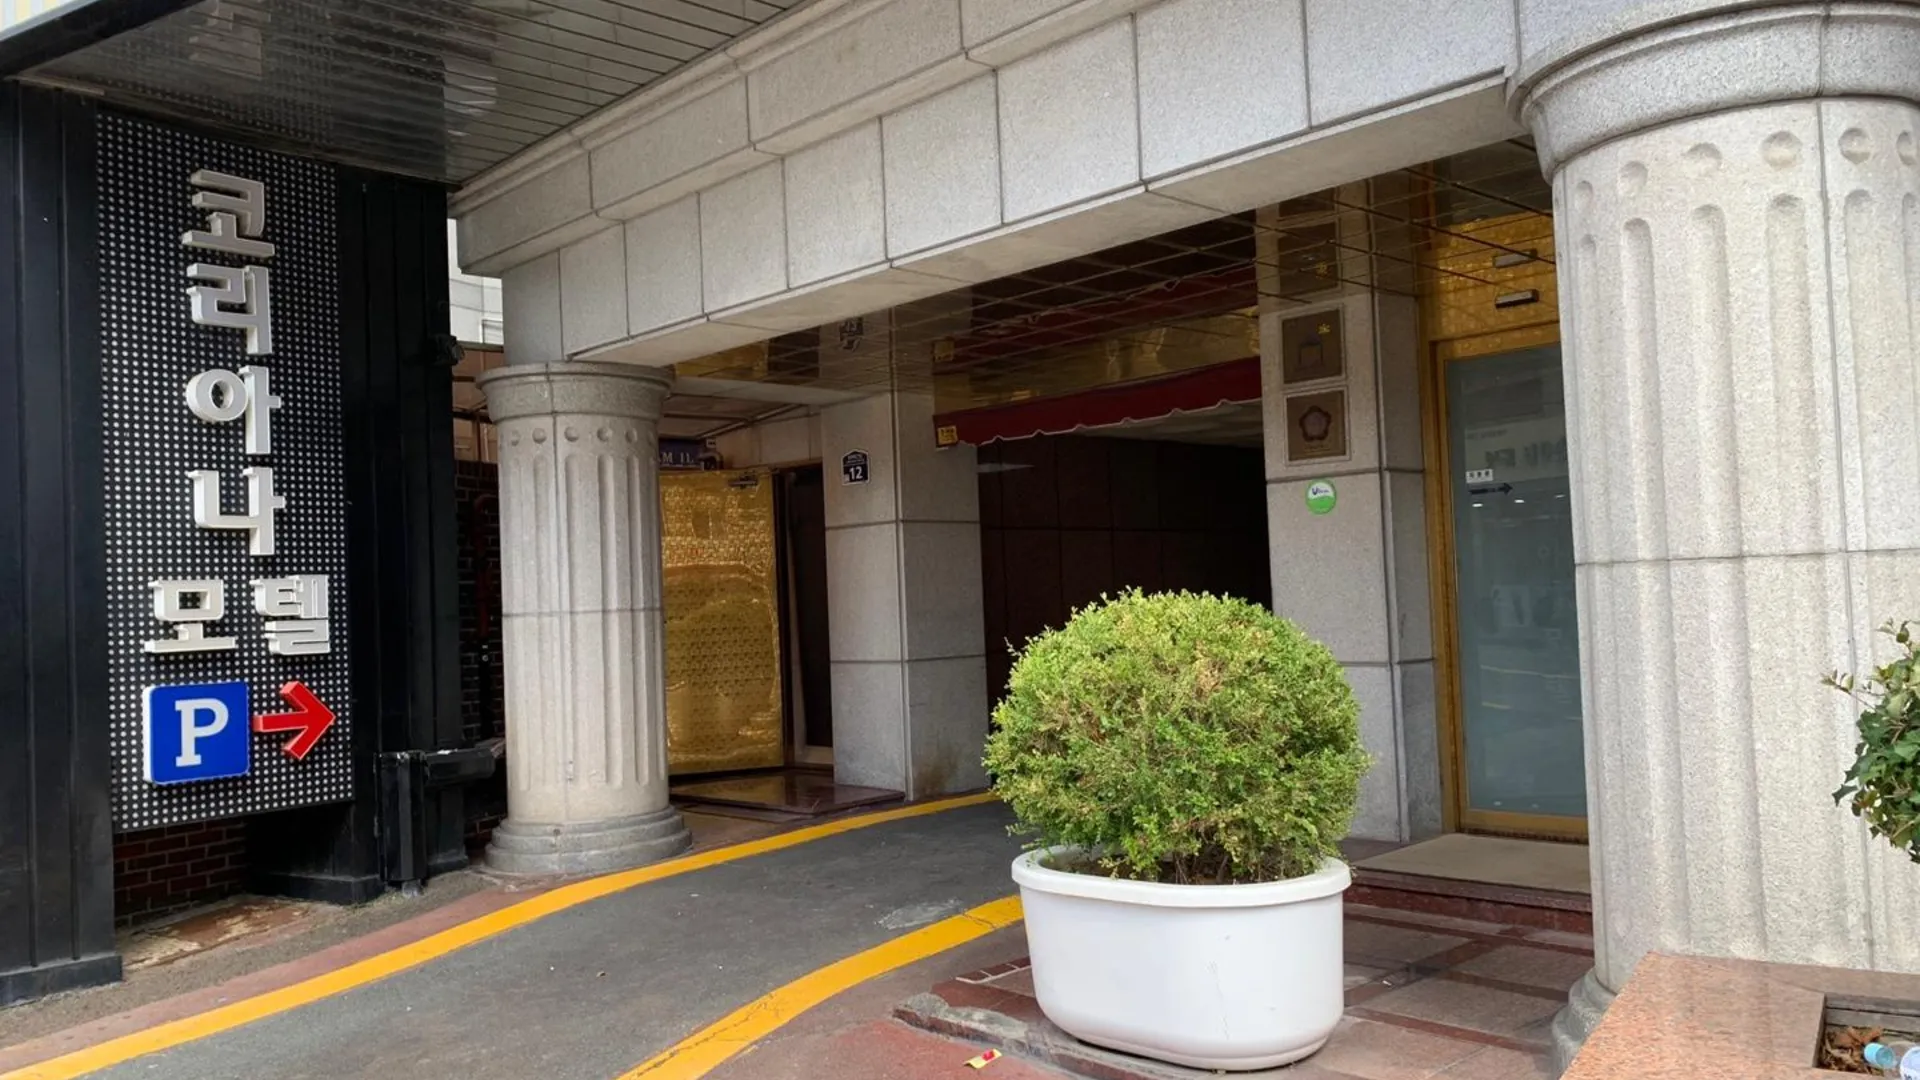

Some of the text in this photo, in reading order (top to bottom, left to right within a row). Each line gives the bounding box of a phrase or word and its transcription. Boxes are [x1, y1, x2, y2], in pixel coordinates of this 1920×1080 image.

[181, 168, 286, 556] 코리아나
[849, 466, 864, 481] 12
[144, 573, 331, 656] 모텔
[174, 698, 229, 768] P
